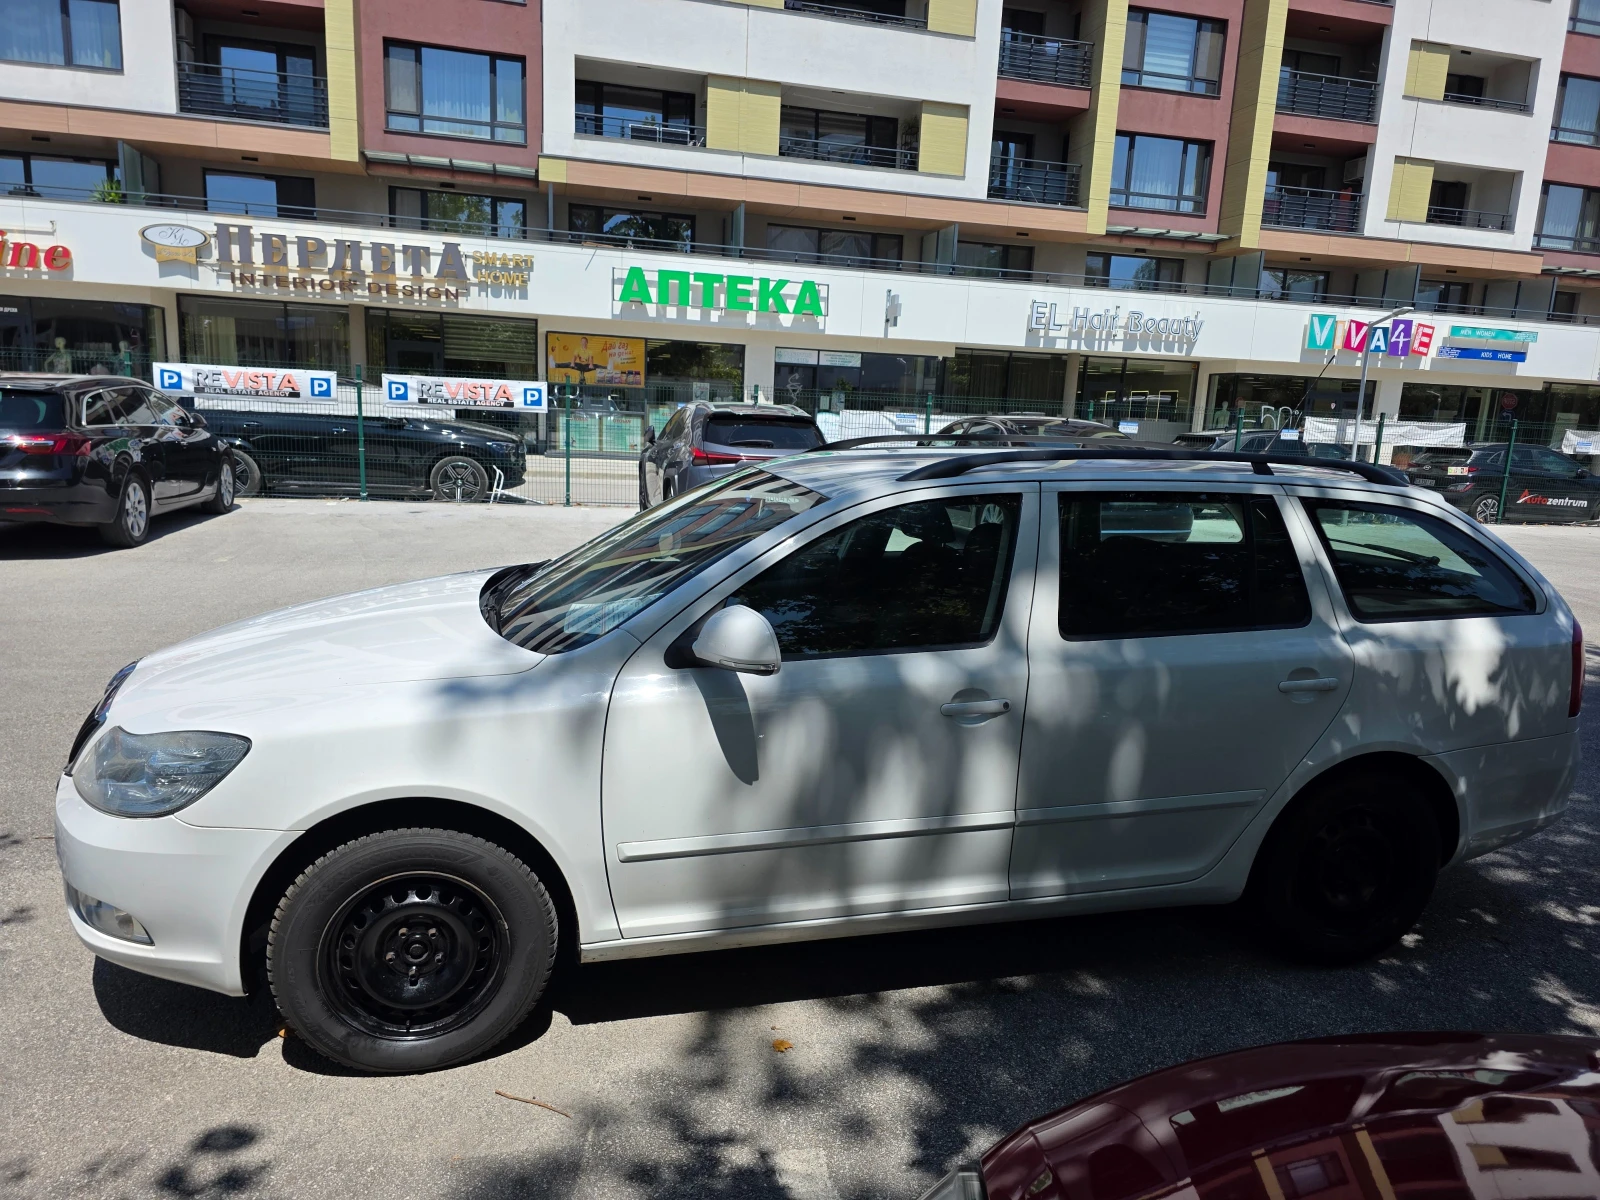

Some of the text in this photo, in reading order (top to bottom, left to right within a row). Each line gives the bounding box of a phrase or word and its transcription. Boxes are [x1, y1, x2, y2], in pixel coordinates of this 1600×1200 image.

[214, 222, 470, 281] ПЕРДЕТА
[472, 250, 535, 269] SMART
[230, 271, 460, 301] INTERIOR DESIGN
[477, 270, 528, 286] HOME
[618, 266, 824, 317] АПТЕКА
[1030, 301, 1205, 342] EL Hair Beauty
[1475, 329, 1496, 337] WOMEN
[1497, 352, 1513, 360] HOME
[192, 368, 300, 392] REVISTA
[204, 387, 290, 397] REAL ESTATE AGENCY
[416, 380, 514, 401] REVISTA
[1516, 488, 1588, 508] Autozentrum
